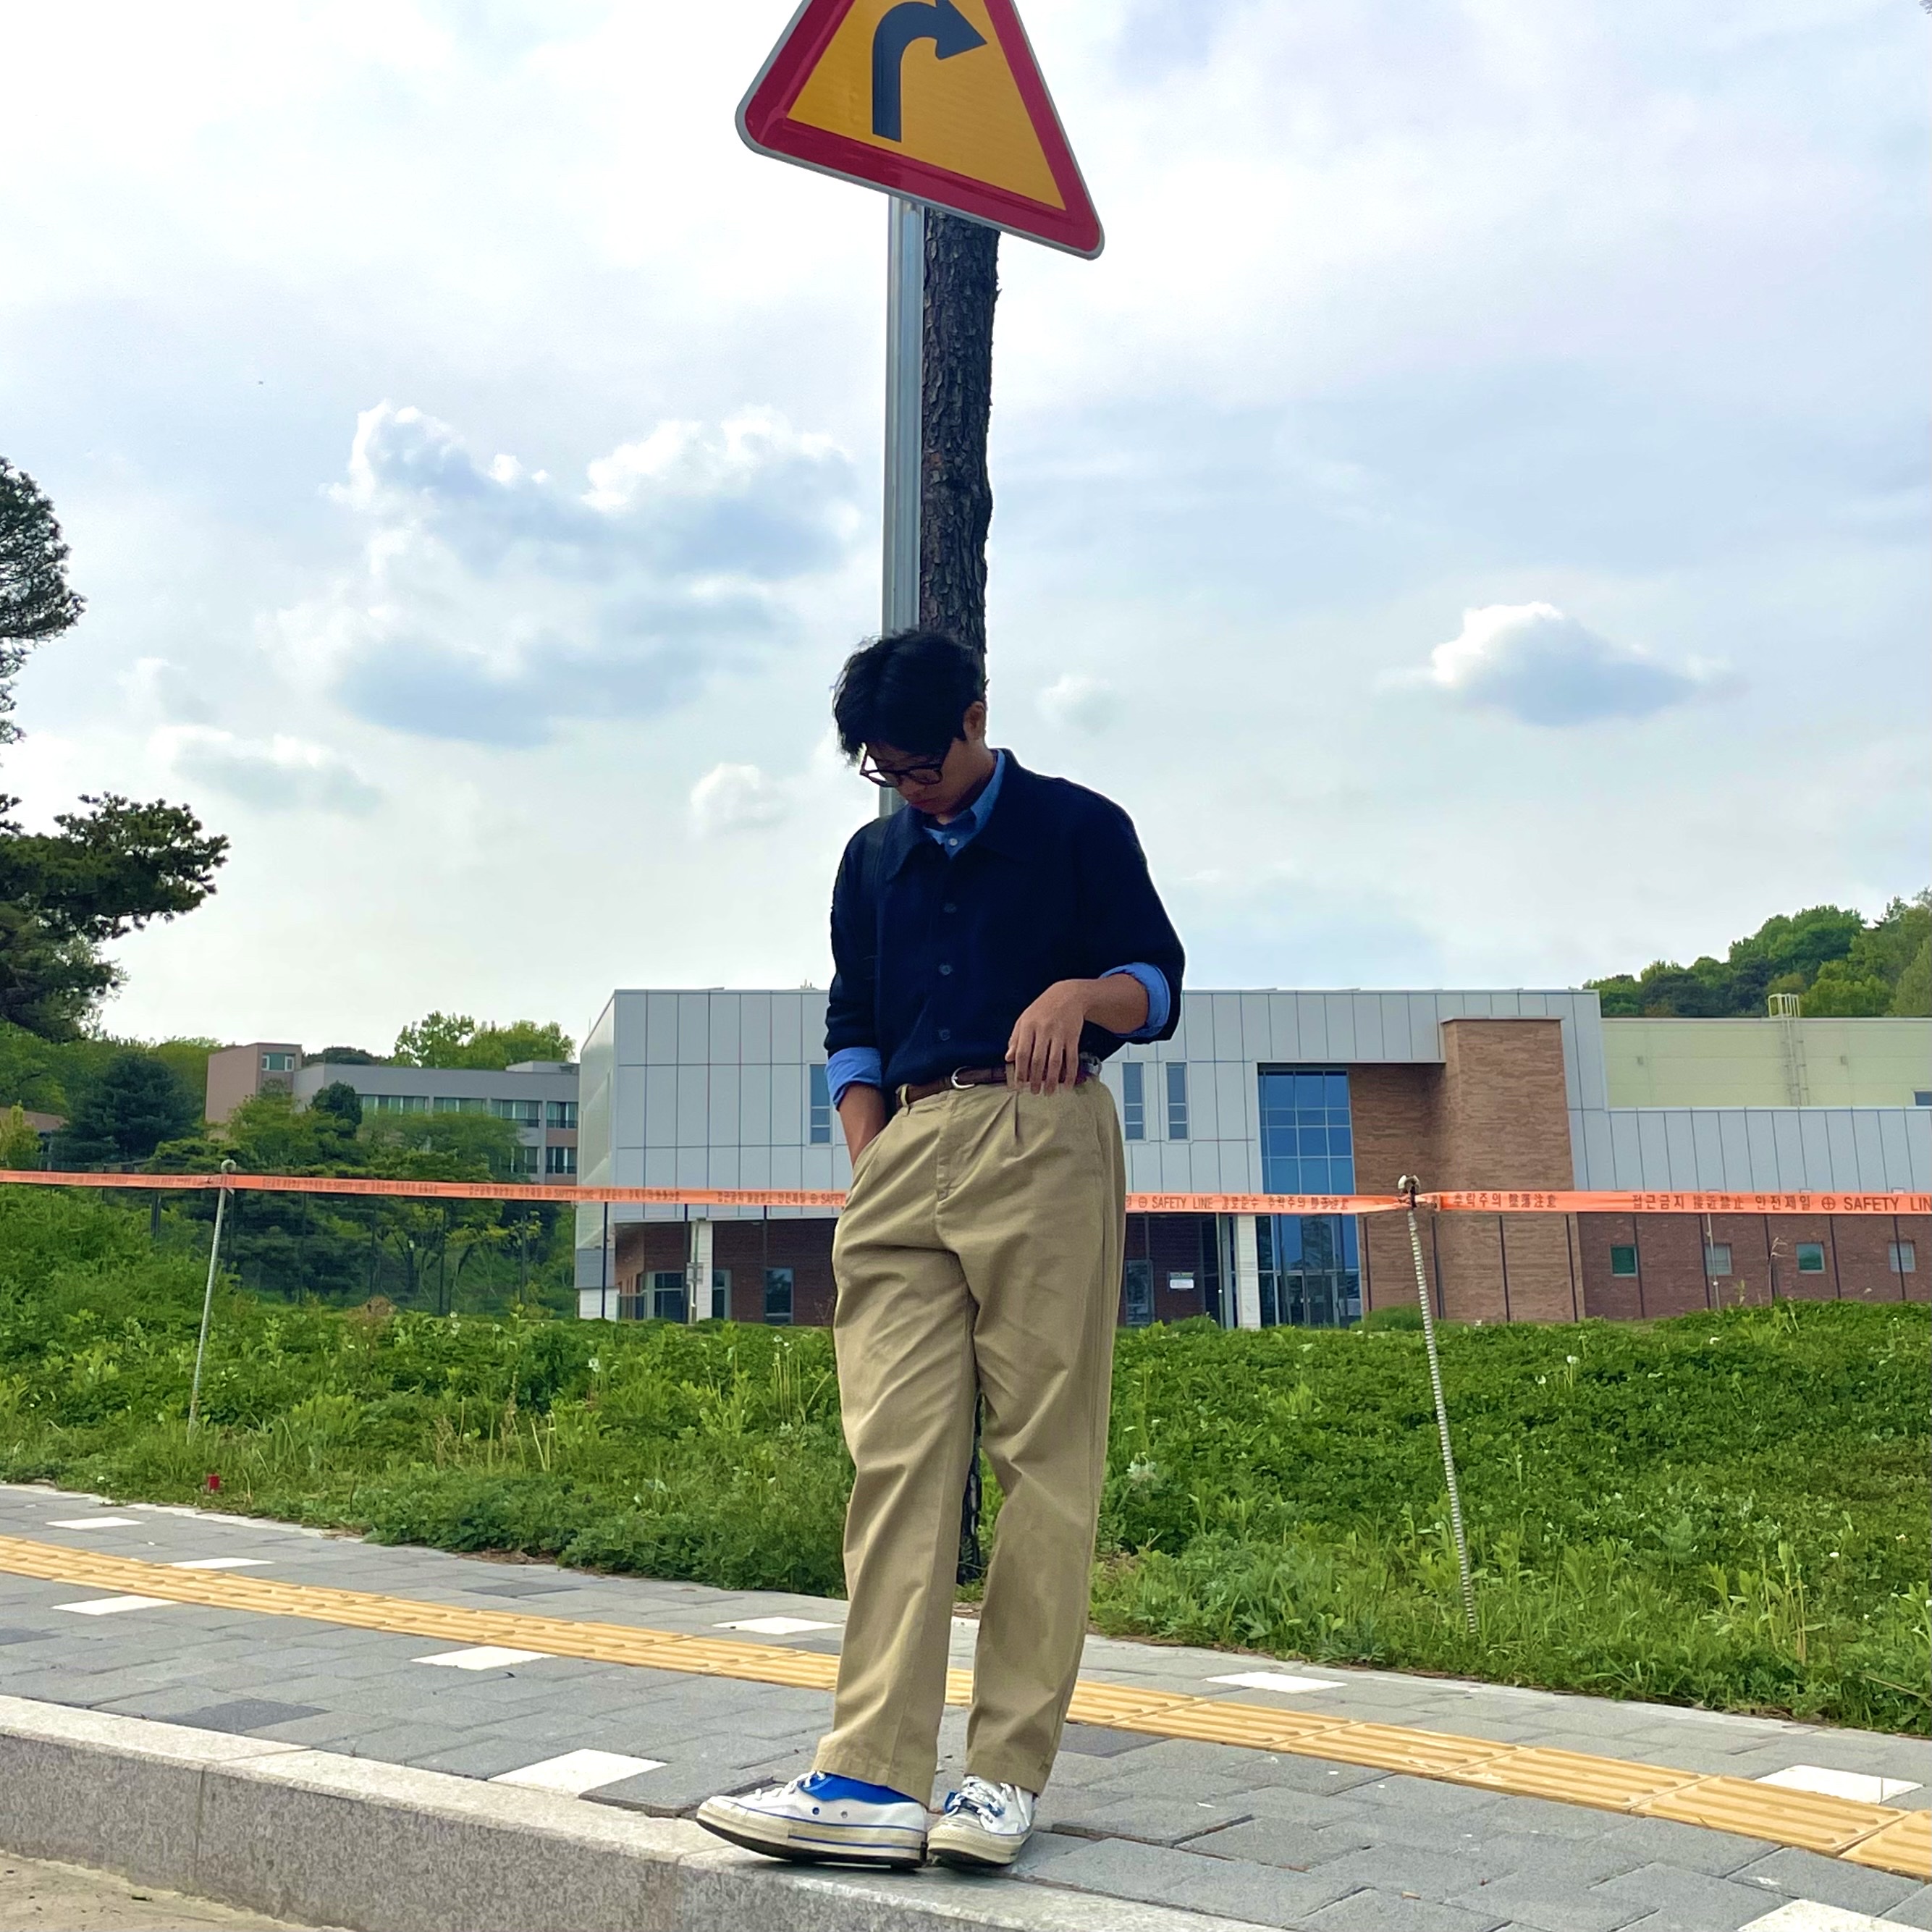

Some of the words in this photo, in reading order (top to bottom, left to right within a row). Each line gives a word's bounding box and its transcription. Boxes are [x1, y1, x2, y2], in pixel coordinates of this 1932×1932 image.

[1152, 1196, 1186, 1209] SAFETY
[1193, 1196, 1213, 1209] LINE
[1453, 1193, 1501, 1207] 추락주의
[1632, 1194, 1684, 1210] 접근금지
[1755, 1195, 1811, 1211] 안전제일
[1844, 1197, 1899, 1212] SAFETY
